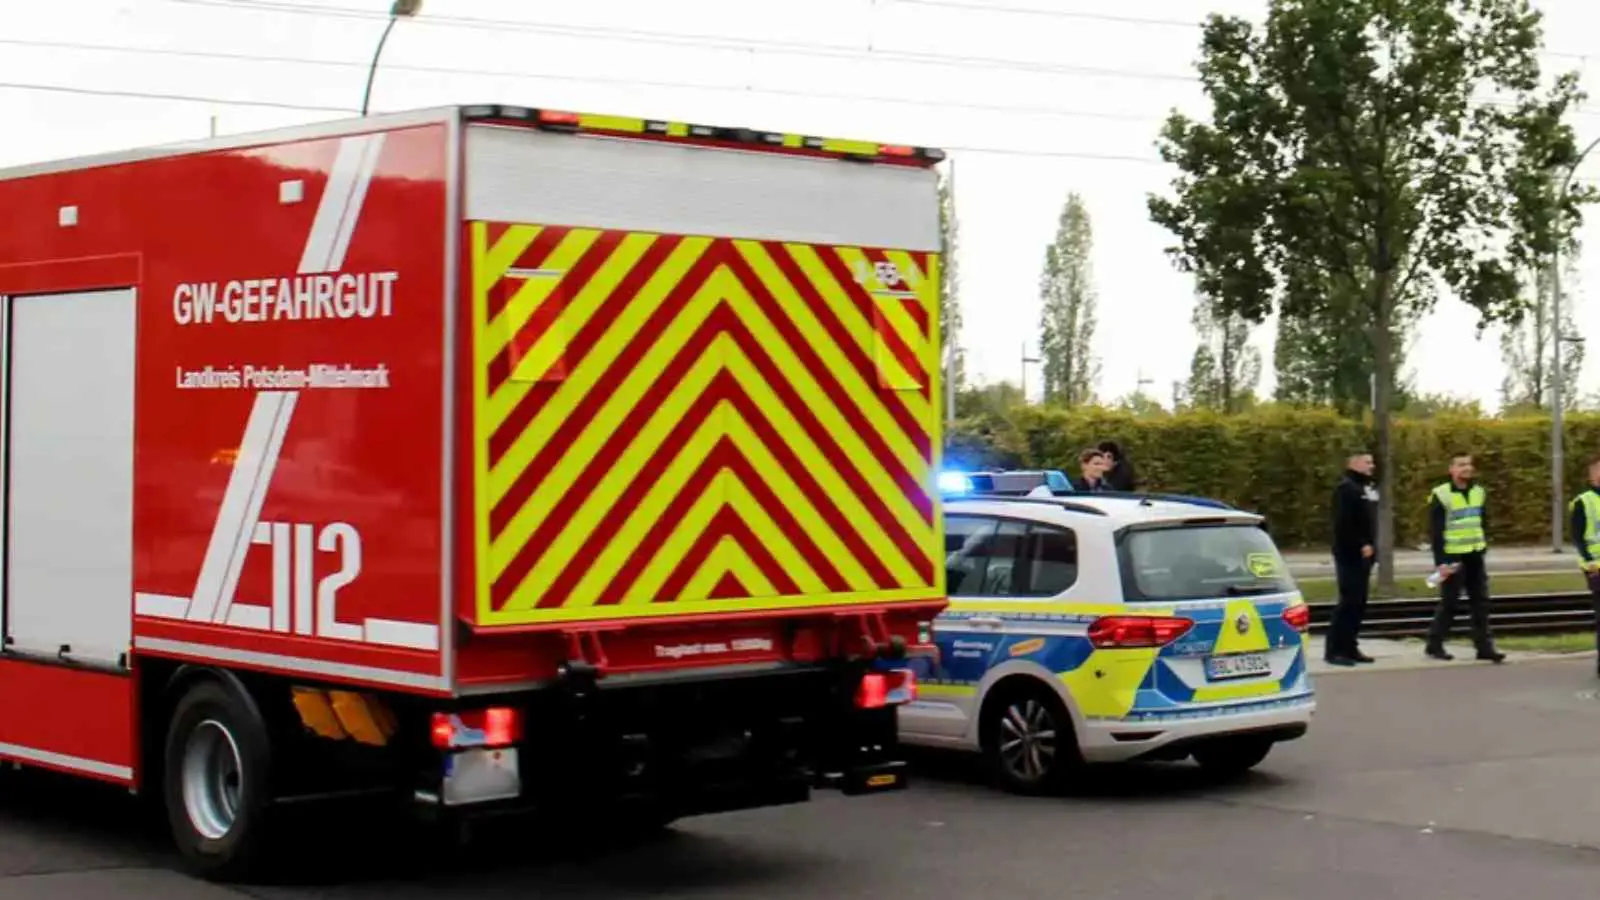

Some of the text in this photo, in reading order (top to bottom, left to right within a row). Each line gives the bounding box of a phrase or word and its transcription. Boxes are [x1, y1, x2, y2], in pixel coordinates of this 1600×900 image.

[173, 272, 398, 325] GW-GEFAHRGUT
[176, 363, 389, 389] Landkreis Potsdam-Mittelmark
[272, 521, 364, 641] 112
